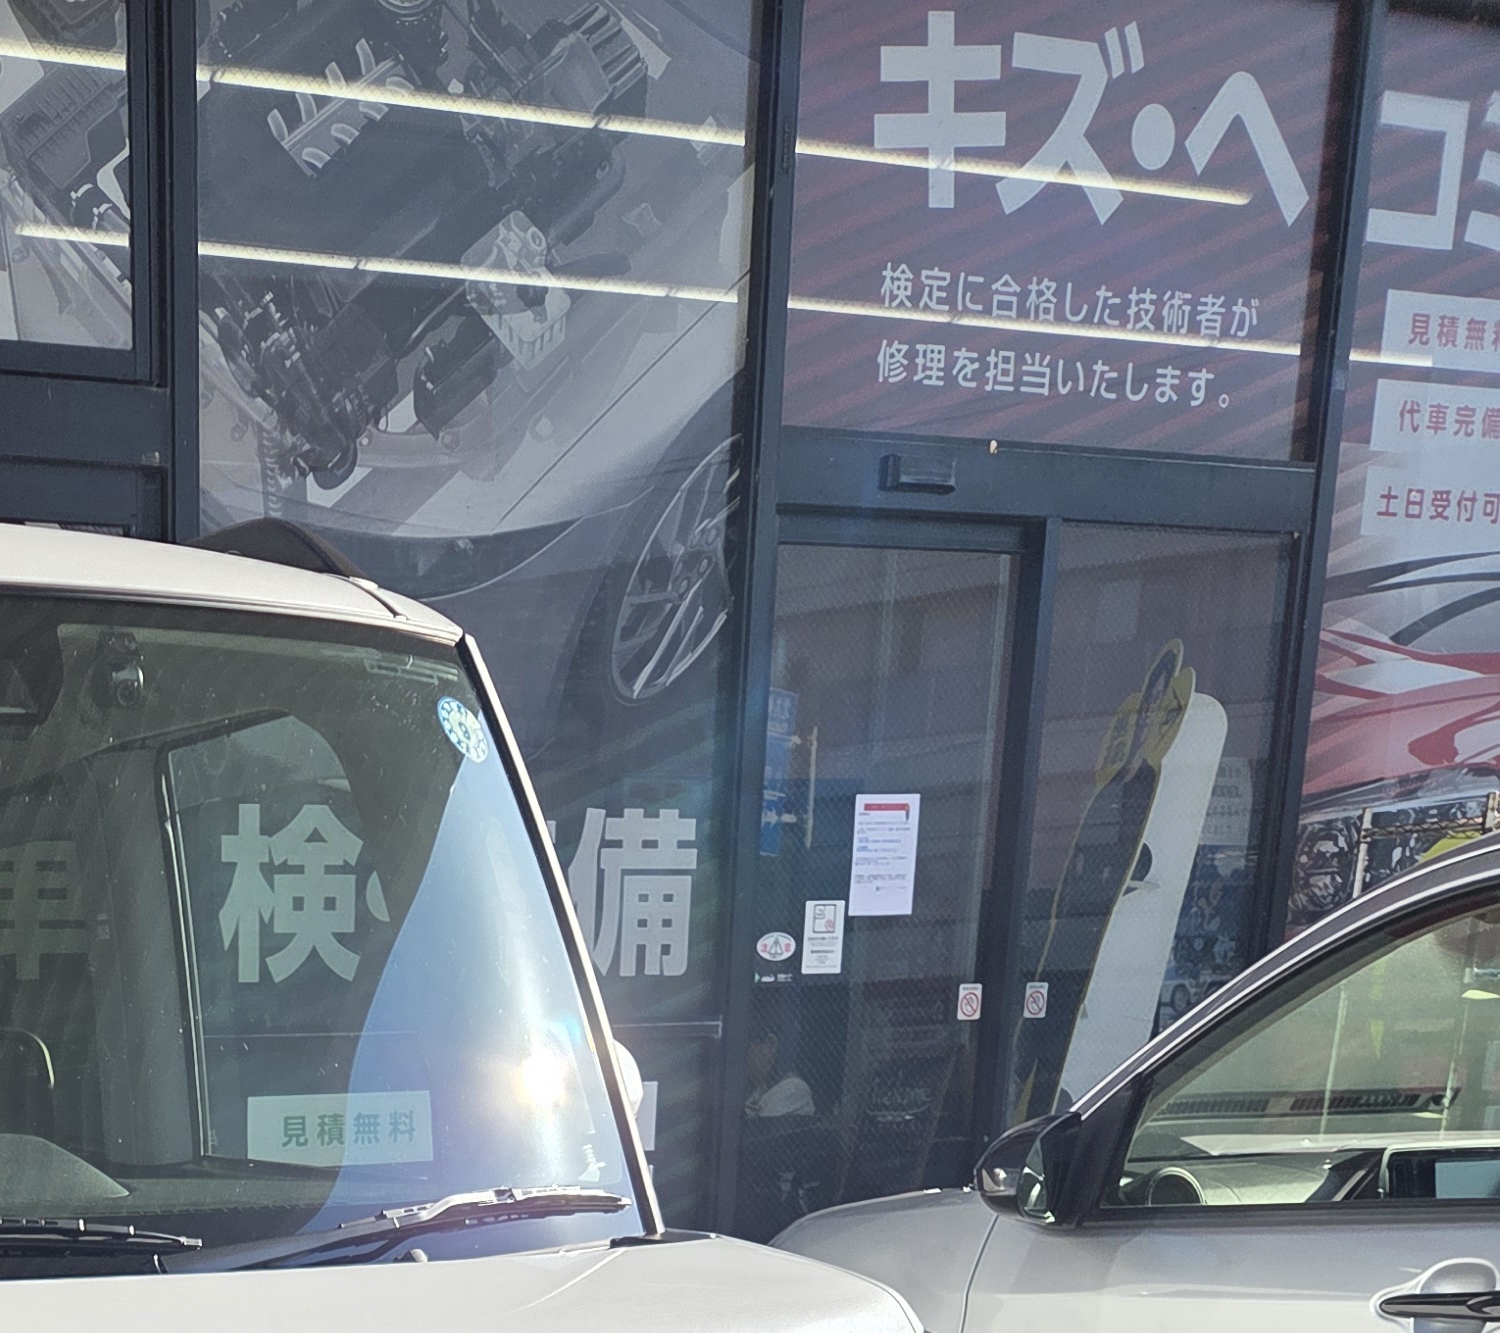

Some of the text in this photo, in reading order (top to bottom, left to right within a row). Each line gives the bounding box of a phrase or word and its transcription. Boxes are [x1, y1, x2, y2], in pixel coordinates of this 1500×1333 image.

[880, 261, 1260, 338] 検定に合格した技術者が
[876, 339, 1230, 409] 修理を担当いたします。
[281, 1109, 416, 1148] 見積無料
